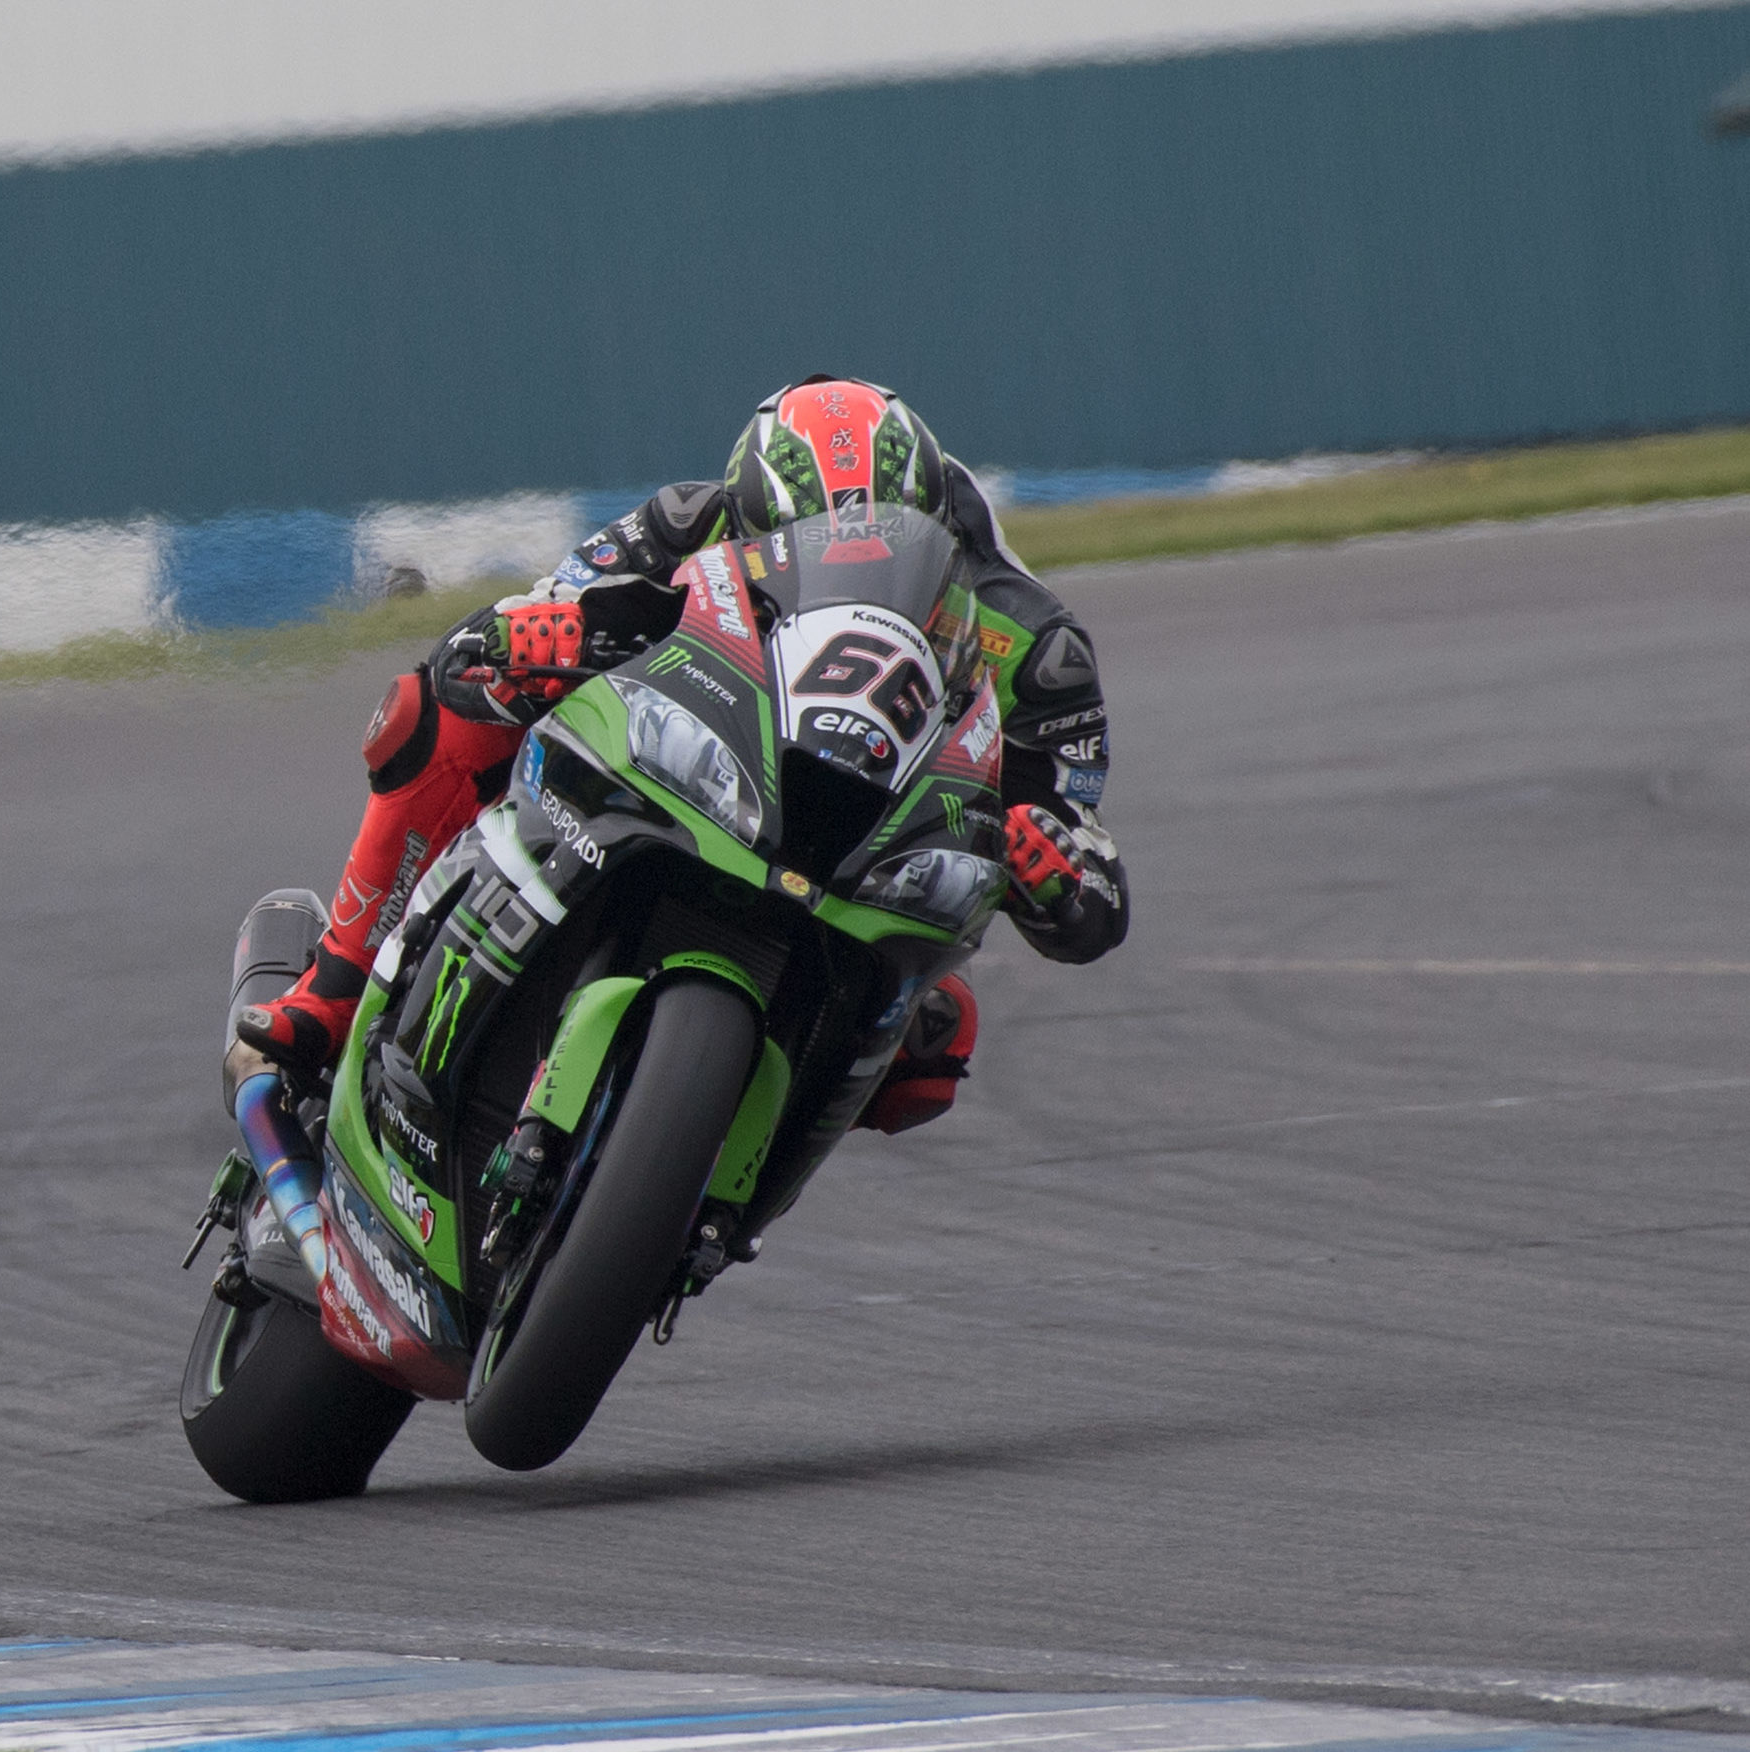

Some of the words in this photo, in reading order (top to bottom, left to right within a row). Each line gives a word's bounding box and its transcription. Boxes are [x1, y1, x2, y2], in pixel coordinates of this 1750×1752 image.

[803, 515, 904, 545] SHARK
[852, 611, 928, 657] Kawasaki
[681, 664, 737, 706] MONSTER
[789, 630, 938, 745] 66
[814, 713, 870, 735] elf
[1059, 736, 1101, 761] elf
[541, 788, 580, 842] GRUPO
[572, 834, 606, 870] ADI
[332, 1176, 433, 1340] Kawasaki
